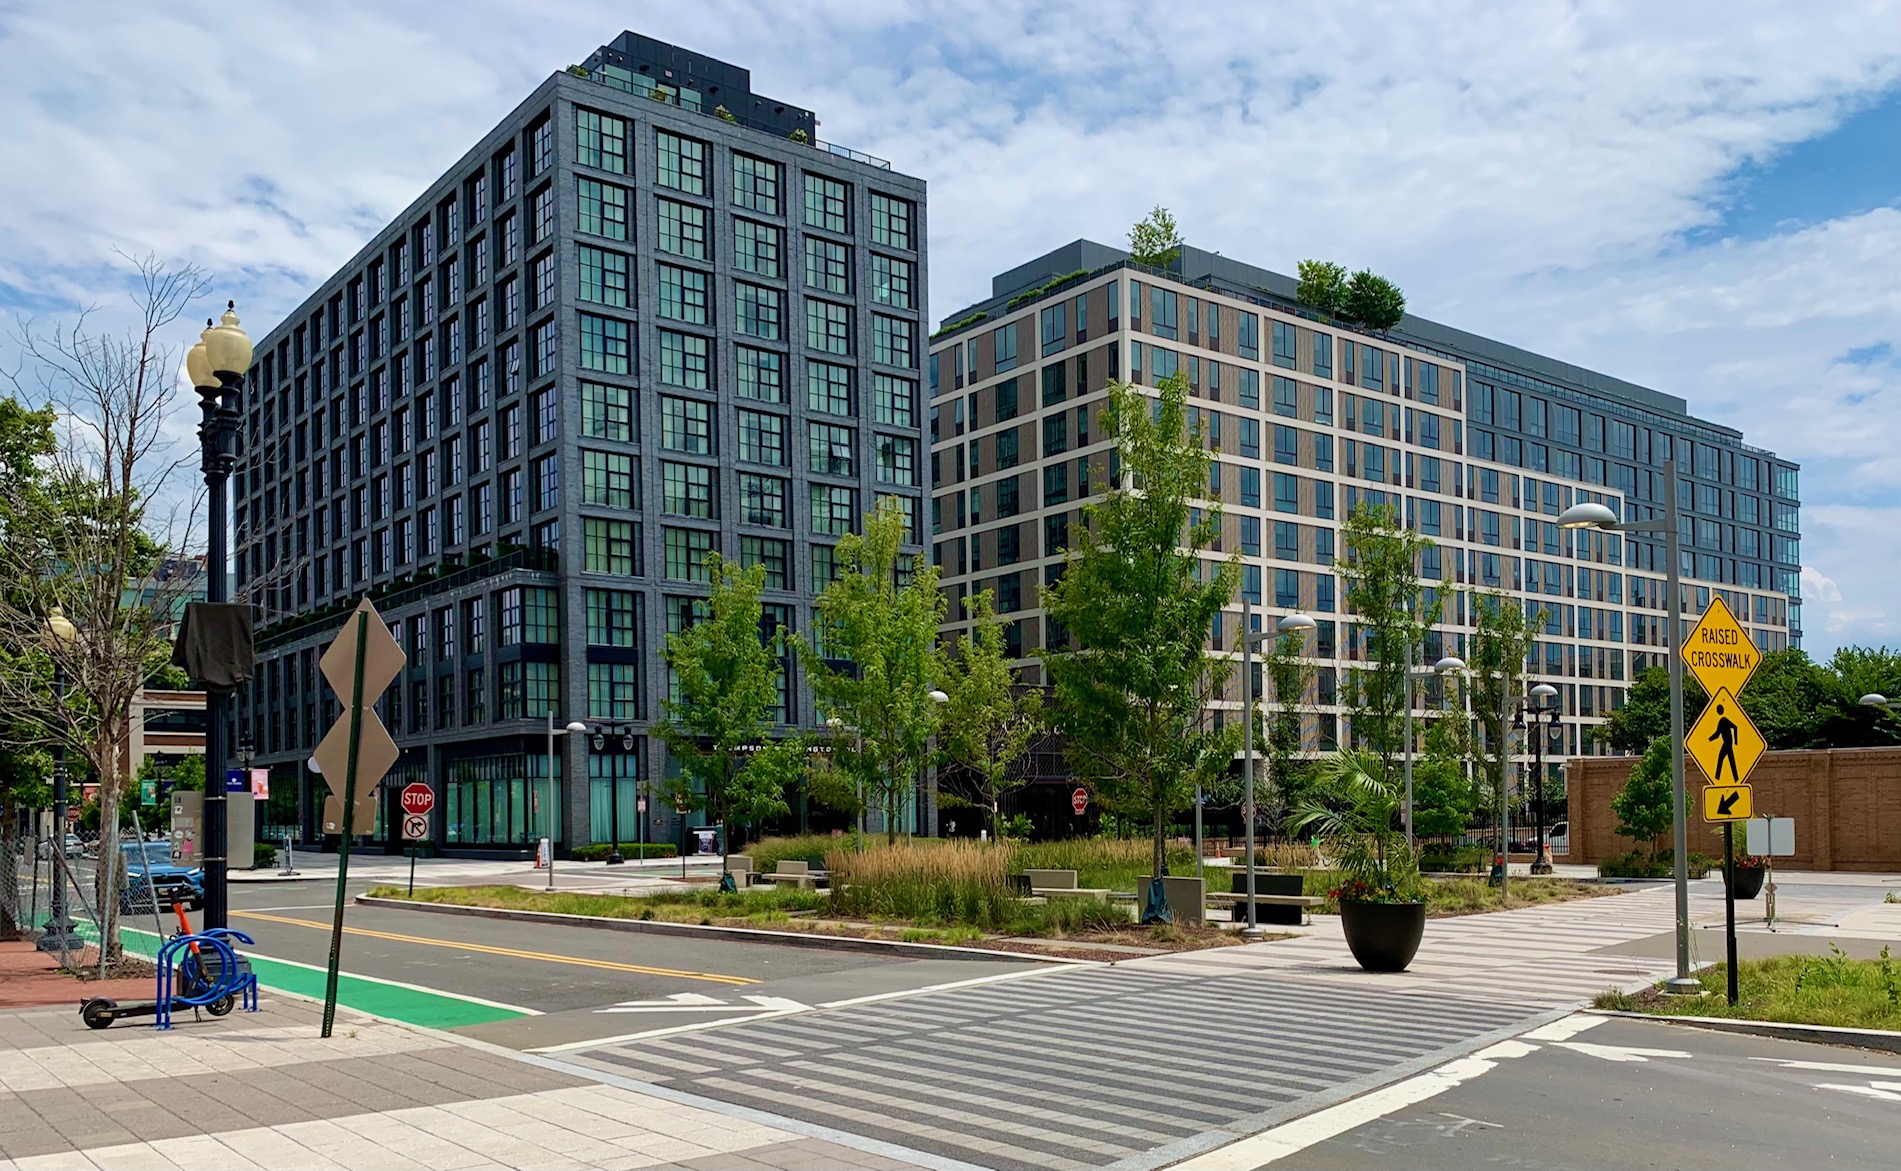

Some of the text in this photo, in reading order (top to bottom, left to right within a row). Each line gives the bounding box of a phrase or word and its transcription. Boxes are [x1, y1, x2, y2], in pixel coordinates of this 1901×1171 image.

[1702, 628, 1738, 645] RAISED
[1691, 650, 1751, 669] CROSSWALK
[404, 792, 432, 805] STOP
